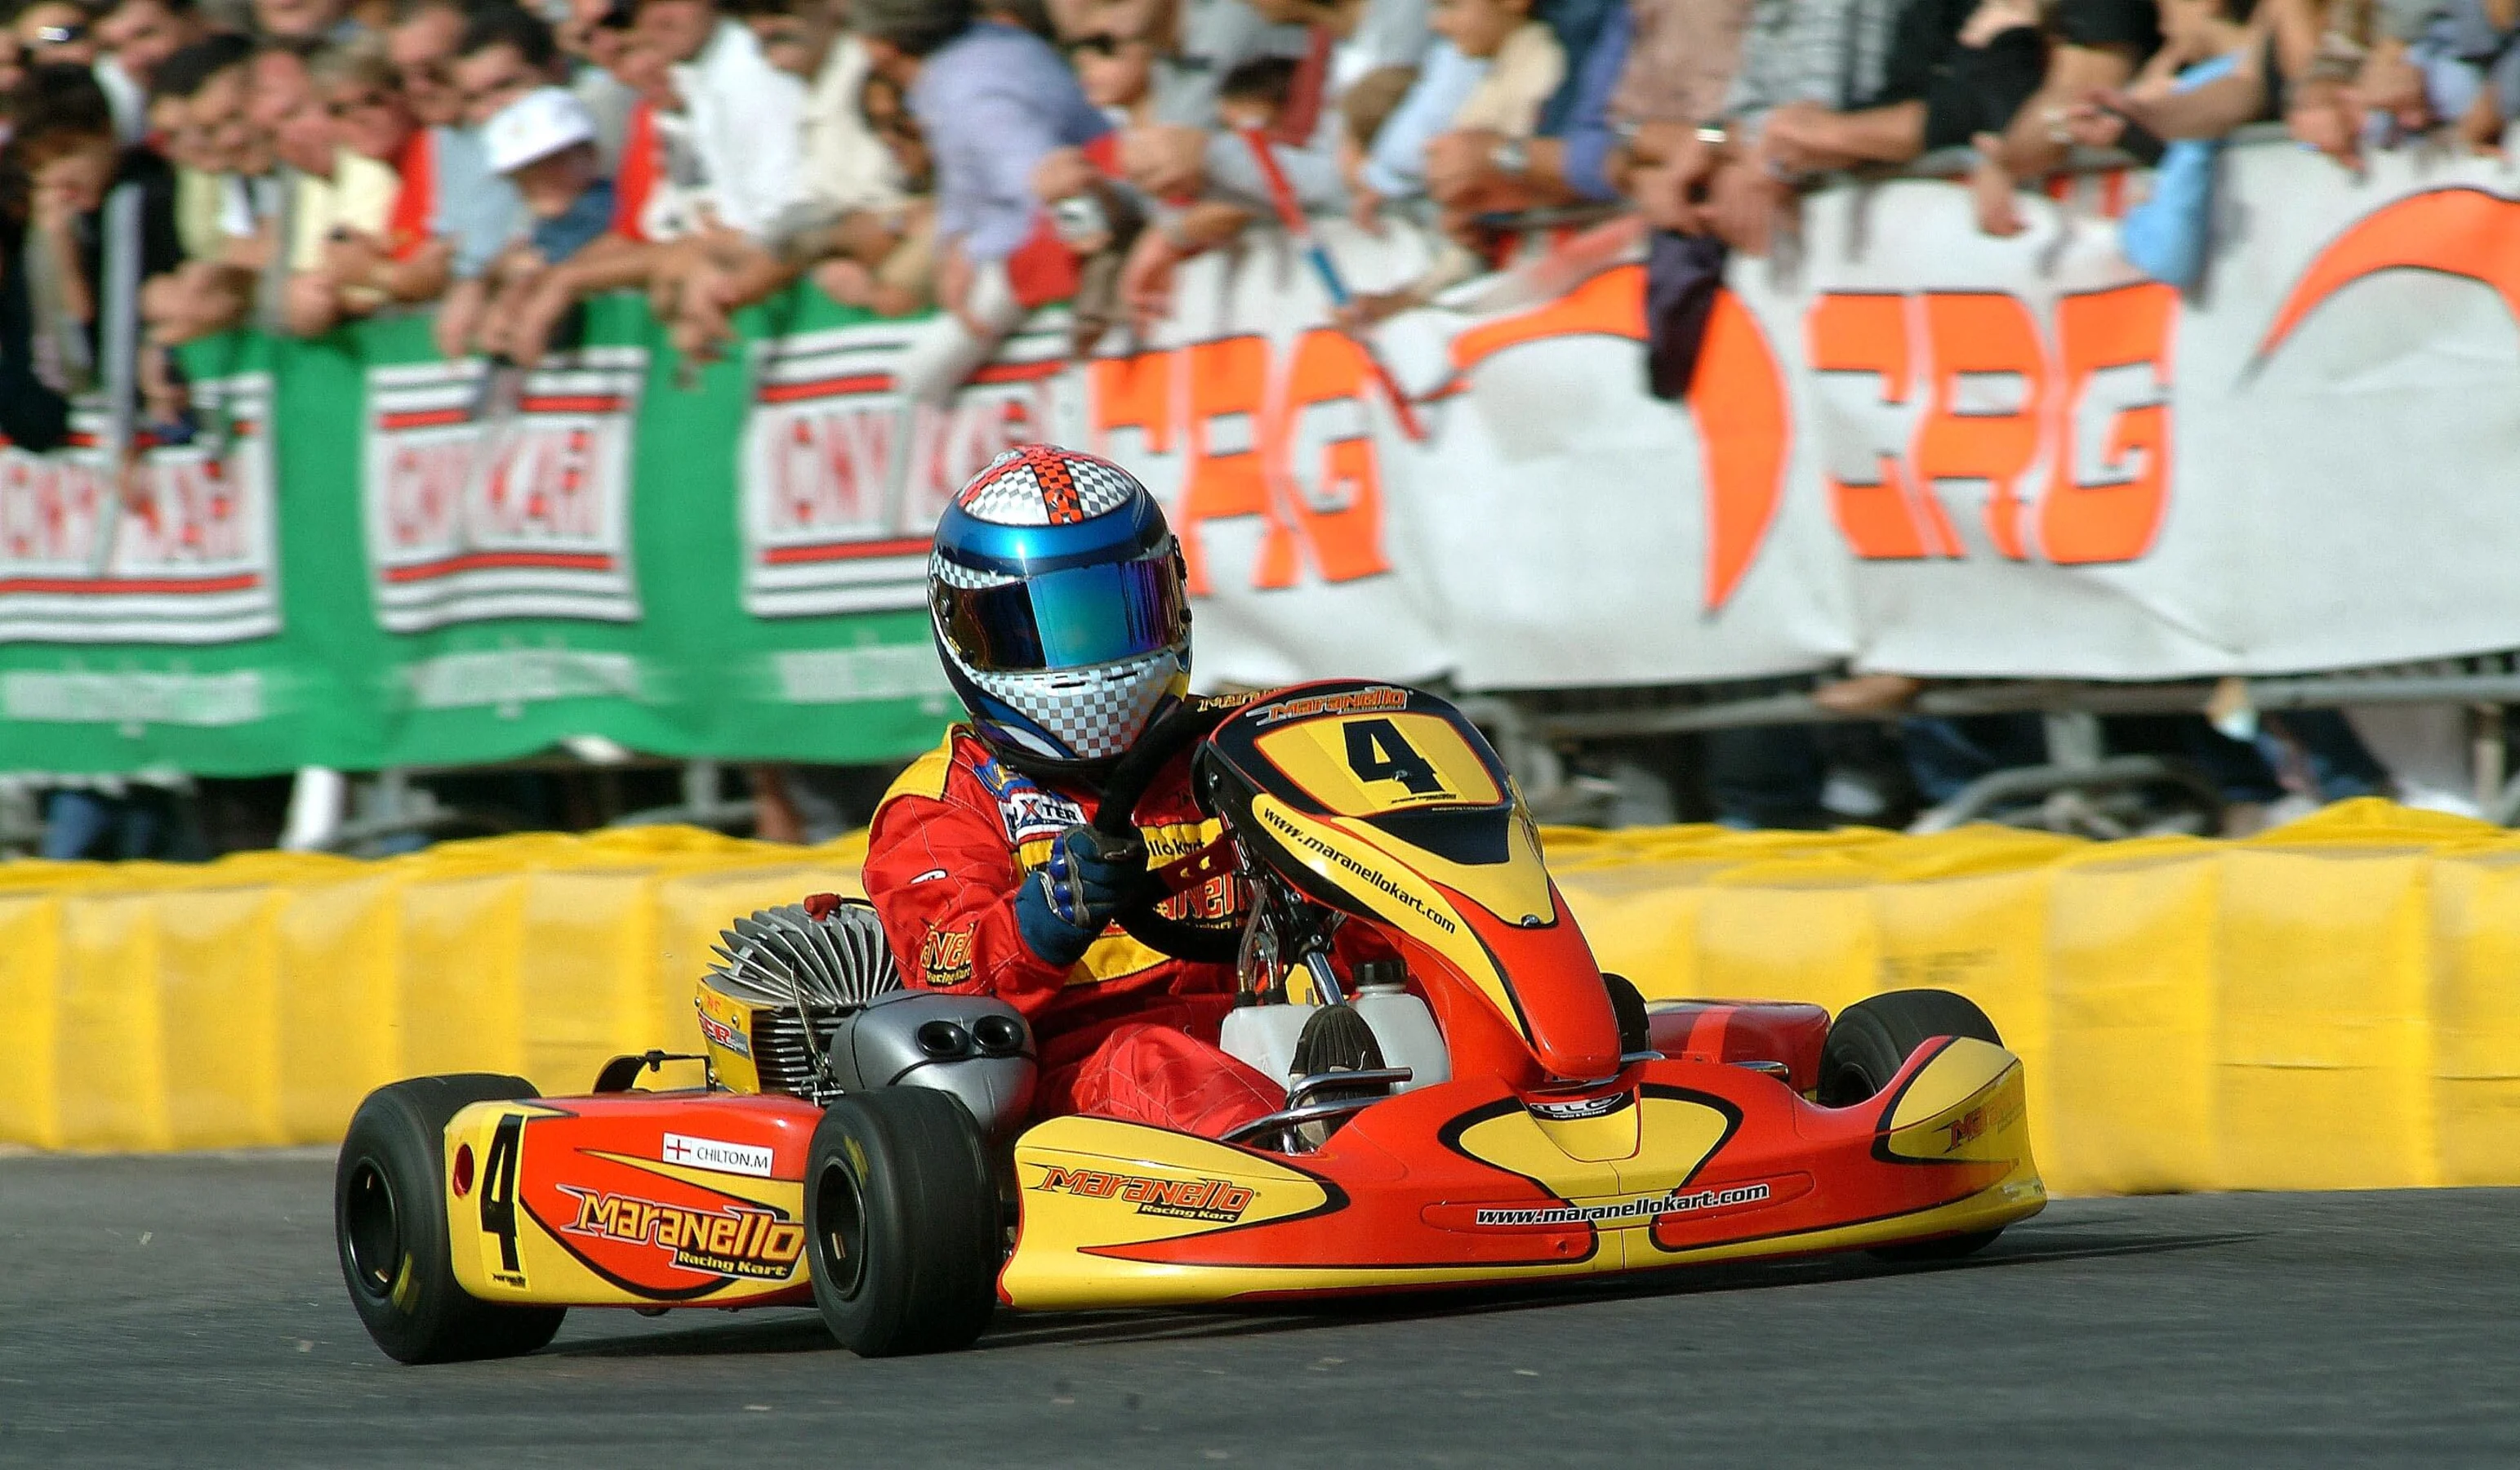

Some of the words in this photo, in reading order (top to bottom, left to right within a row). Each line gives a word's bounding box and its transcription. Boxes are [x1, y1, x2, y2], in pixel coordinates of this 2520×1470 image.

[1801, 281, 2184, 565] CRG
[1343, 719, 1445, 794] 4
[1263, 807, 1456, 934] www.maranellokart.com
[697, 1146, 768, 1170] CHILTON.M
[480, 1113, 523, 1272] 4
[1032, 1165, 1254, 1212] Maranello
[1142, 1204, 1195, 1220] Racing
[1199, 1210, 1236, 1222] Kart
[1476, 1184, 1770, 1225] www.maranellokart.com
[568, 1189, 805, 1263] Maranello
[677, 1250, 736, 1273] Racing
[736, 1261, 788, 1277] Kart
